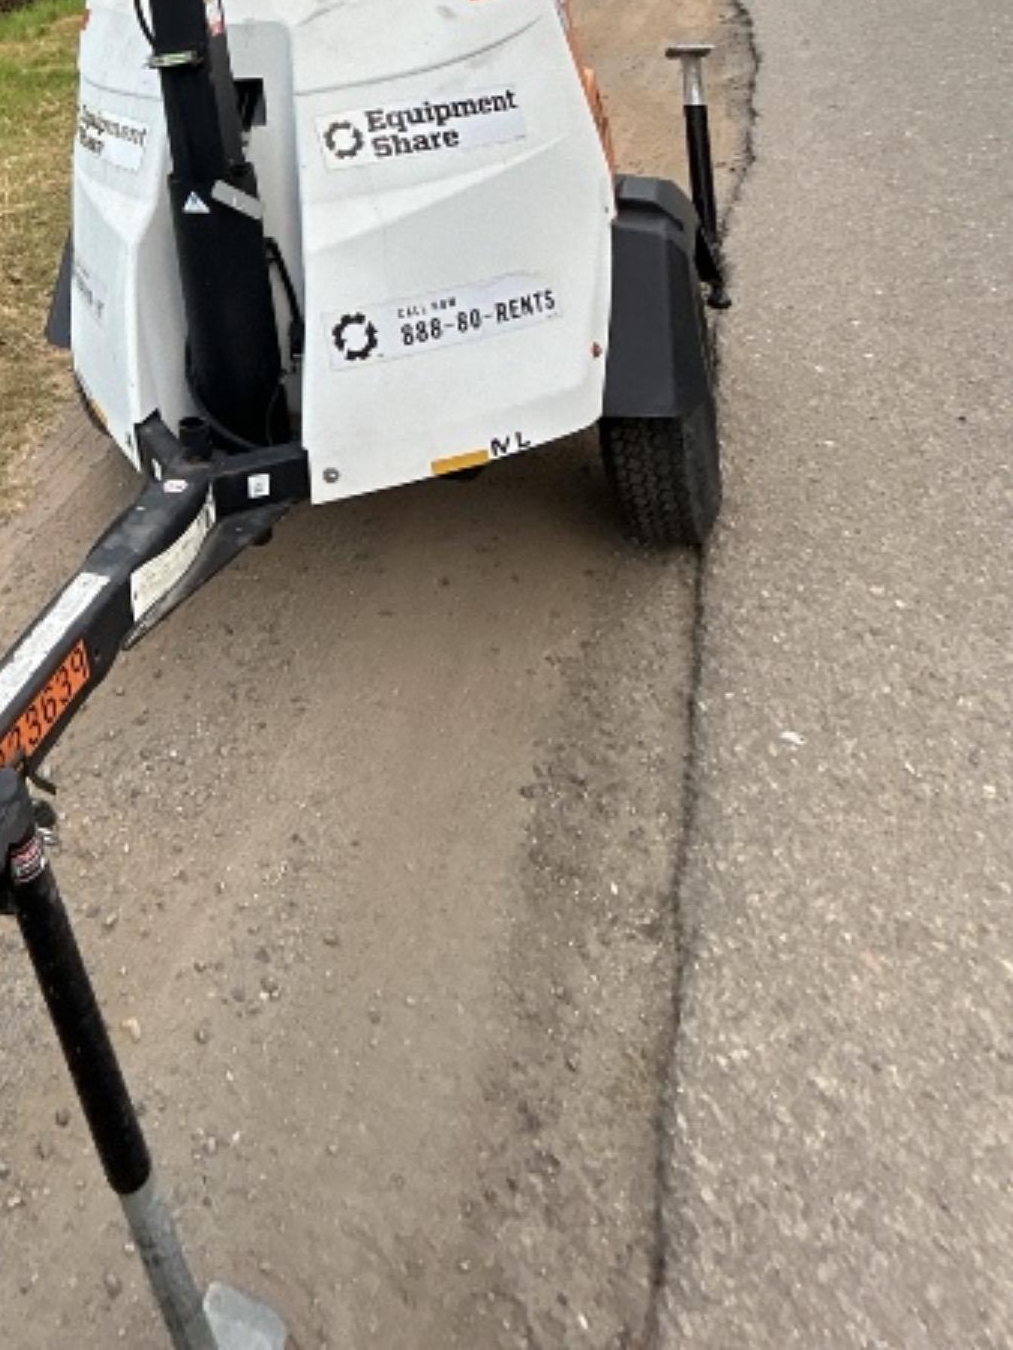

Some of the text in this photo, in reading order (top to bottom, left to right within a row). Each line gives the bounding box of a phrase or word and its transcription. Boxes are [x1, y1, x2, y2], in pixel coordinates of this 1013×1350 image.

[364, 89, 519, 132] Equipment
[371, 128, 460, 158] Share
[401, 289, 556, 346] 888-80-RENTS
